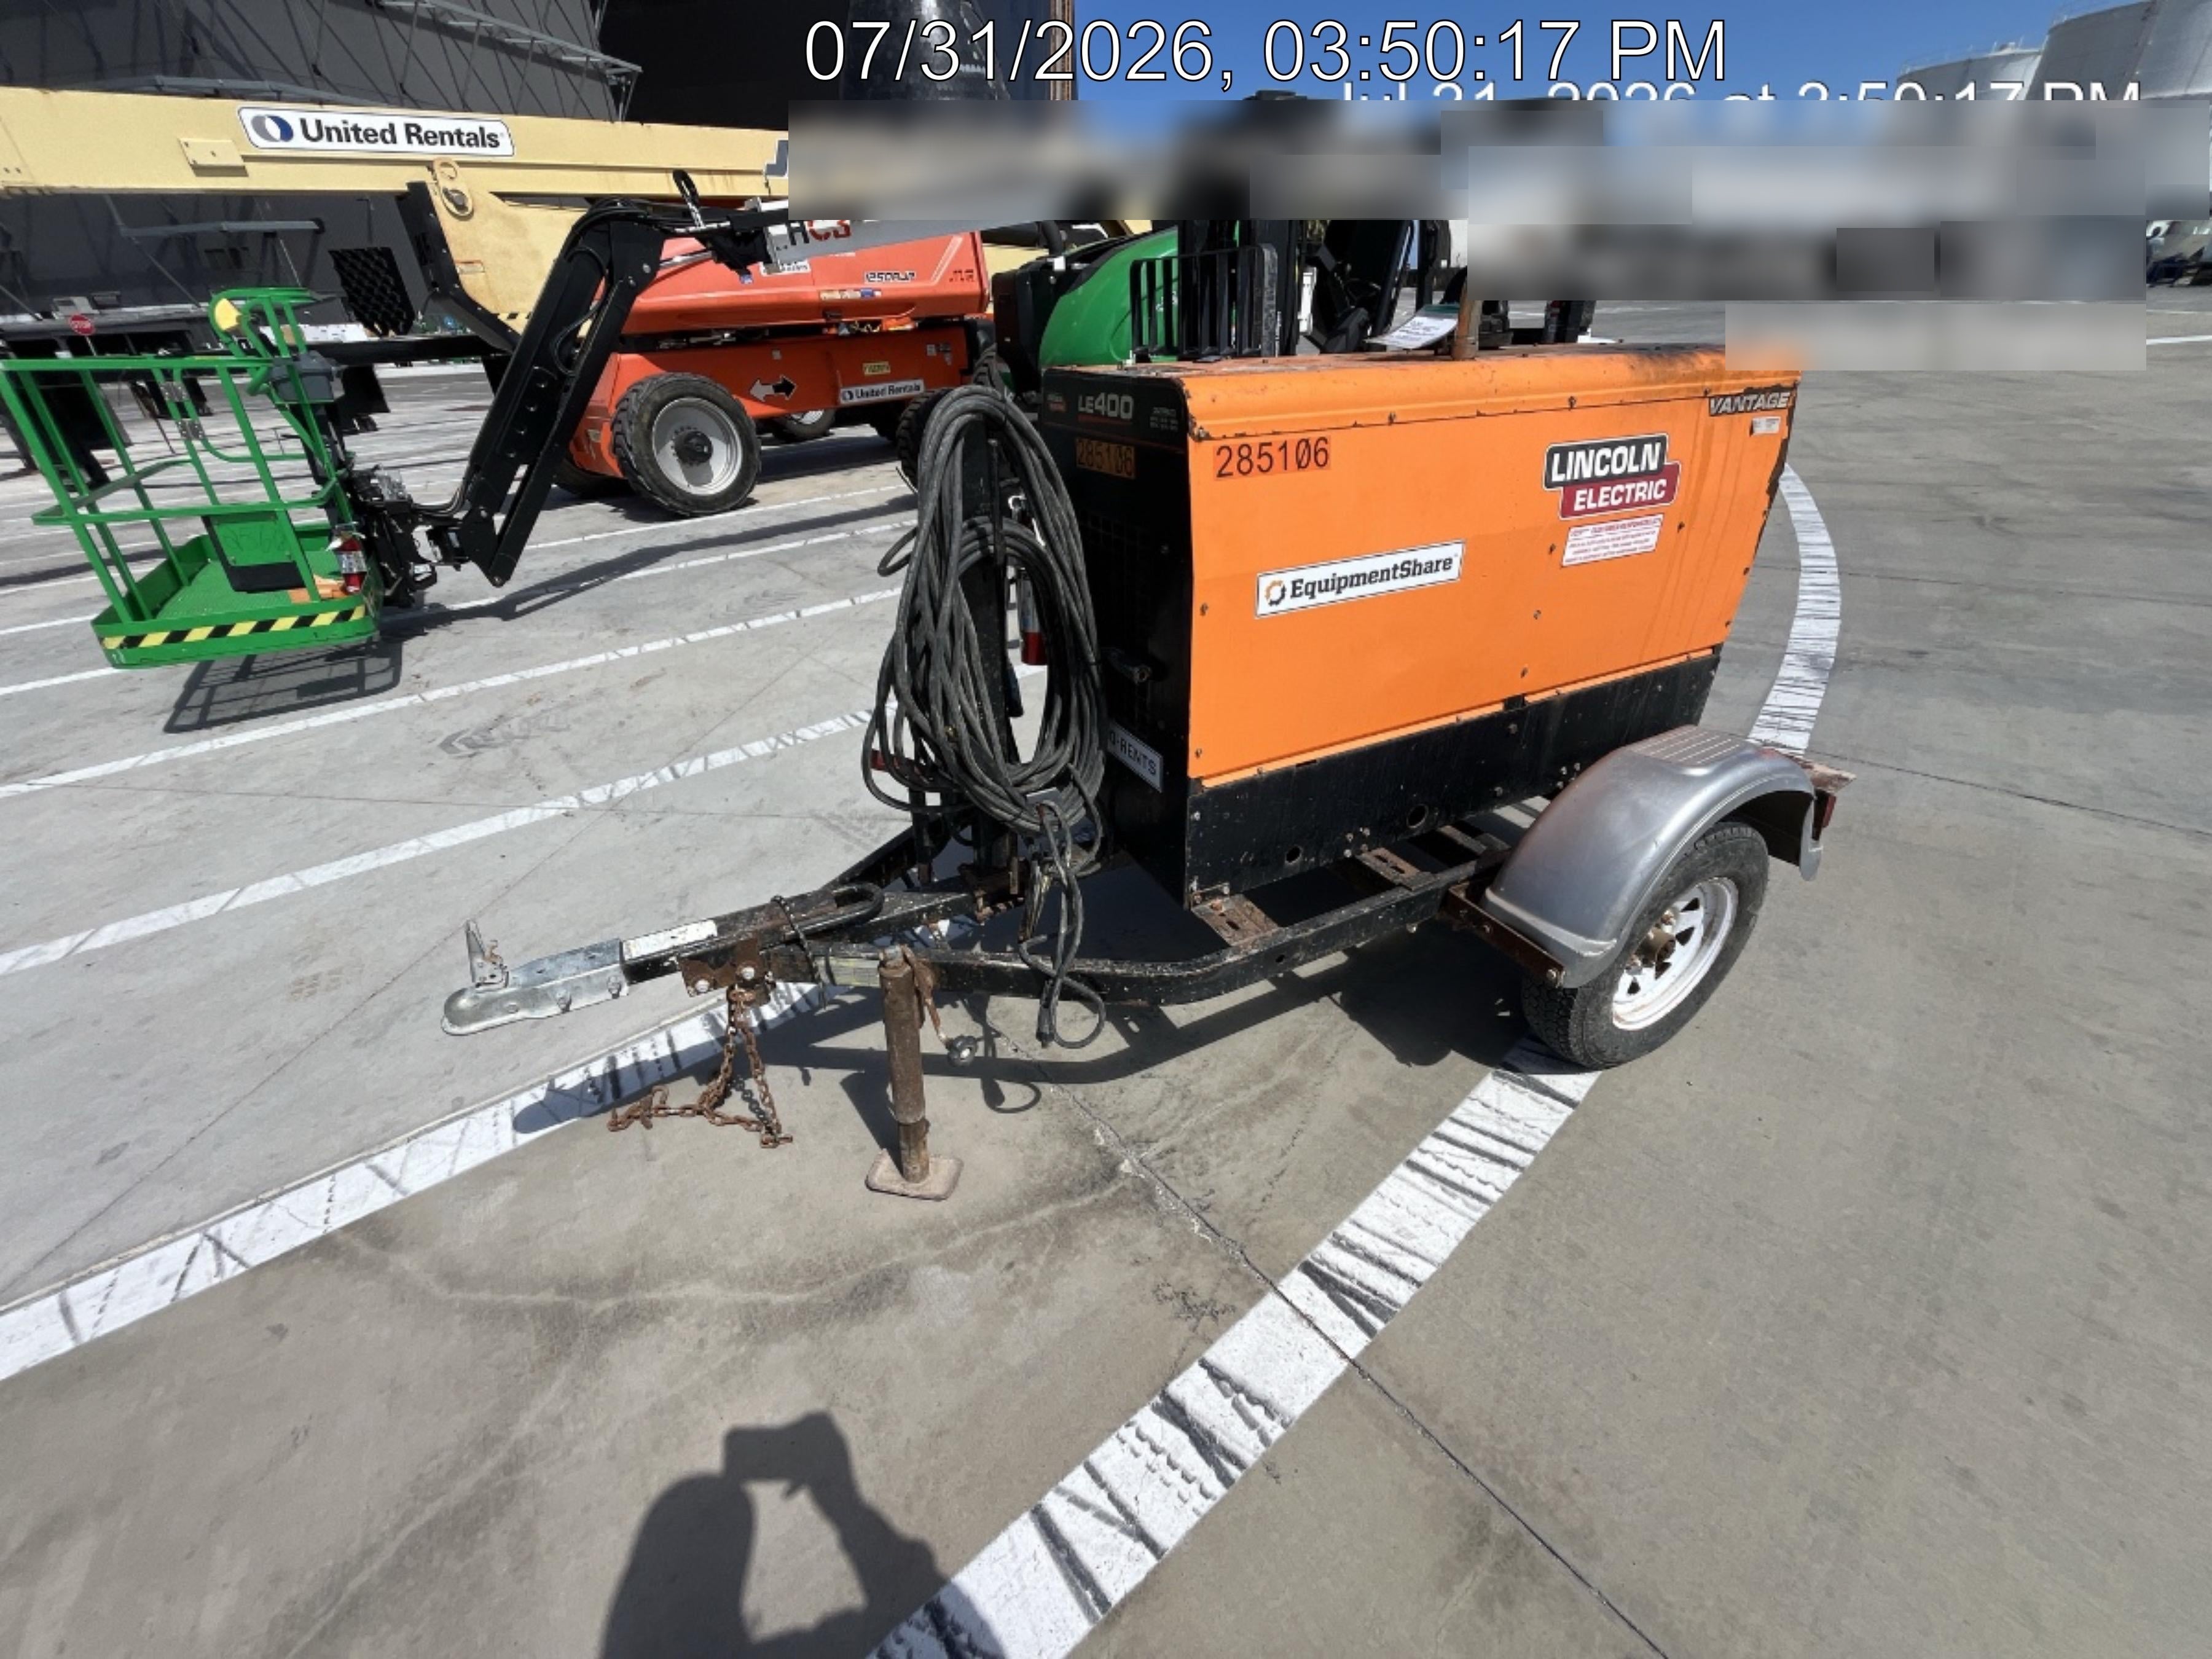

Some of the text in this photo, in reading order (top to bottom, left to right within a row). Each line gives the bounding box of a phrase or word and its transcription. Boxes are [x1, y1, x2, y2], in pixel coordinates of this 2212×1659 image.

[300, 118, 500, 148] United Rentals
[855, 386, 884, 399] United
[1078, 392, 1134, 419] LE400
[1710, 392, 1790, 415] VANTAGE
[1216, 437, 1329, 478] 285106
[1551, 442, 1661, 482] LINCOLN
[1574, 479, 1667, 512] ELECTRIC
[1290, 557, 1453, 600] EquipmentShare
